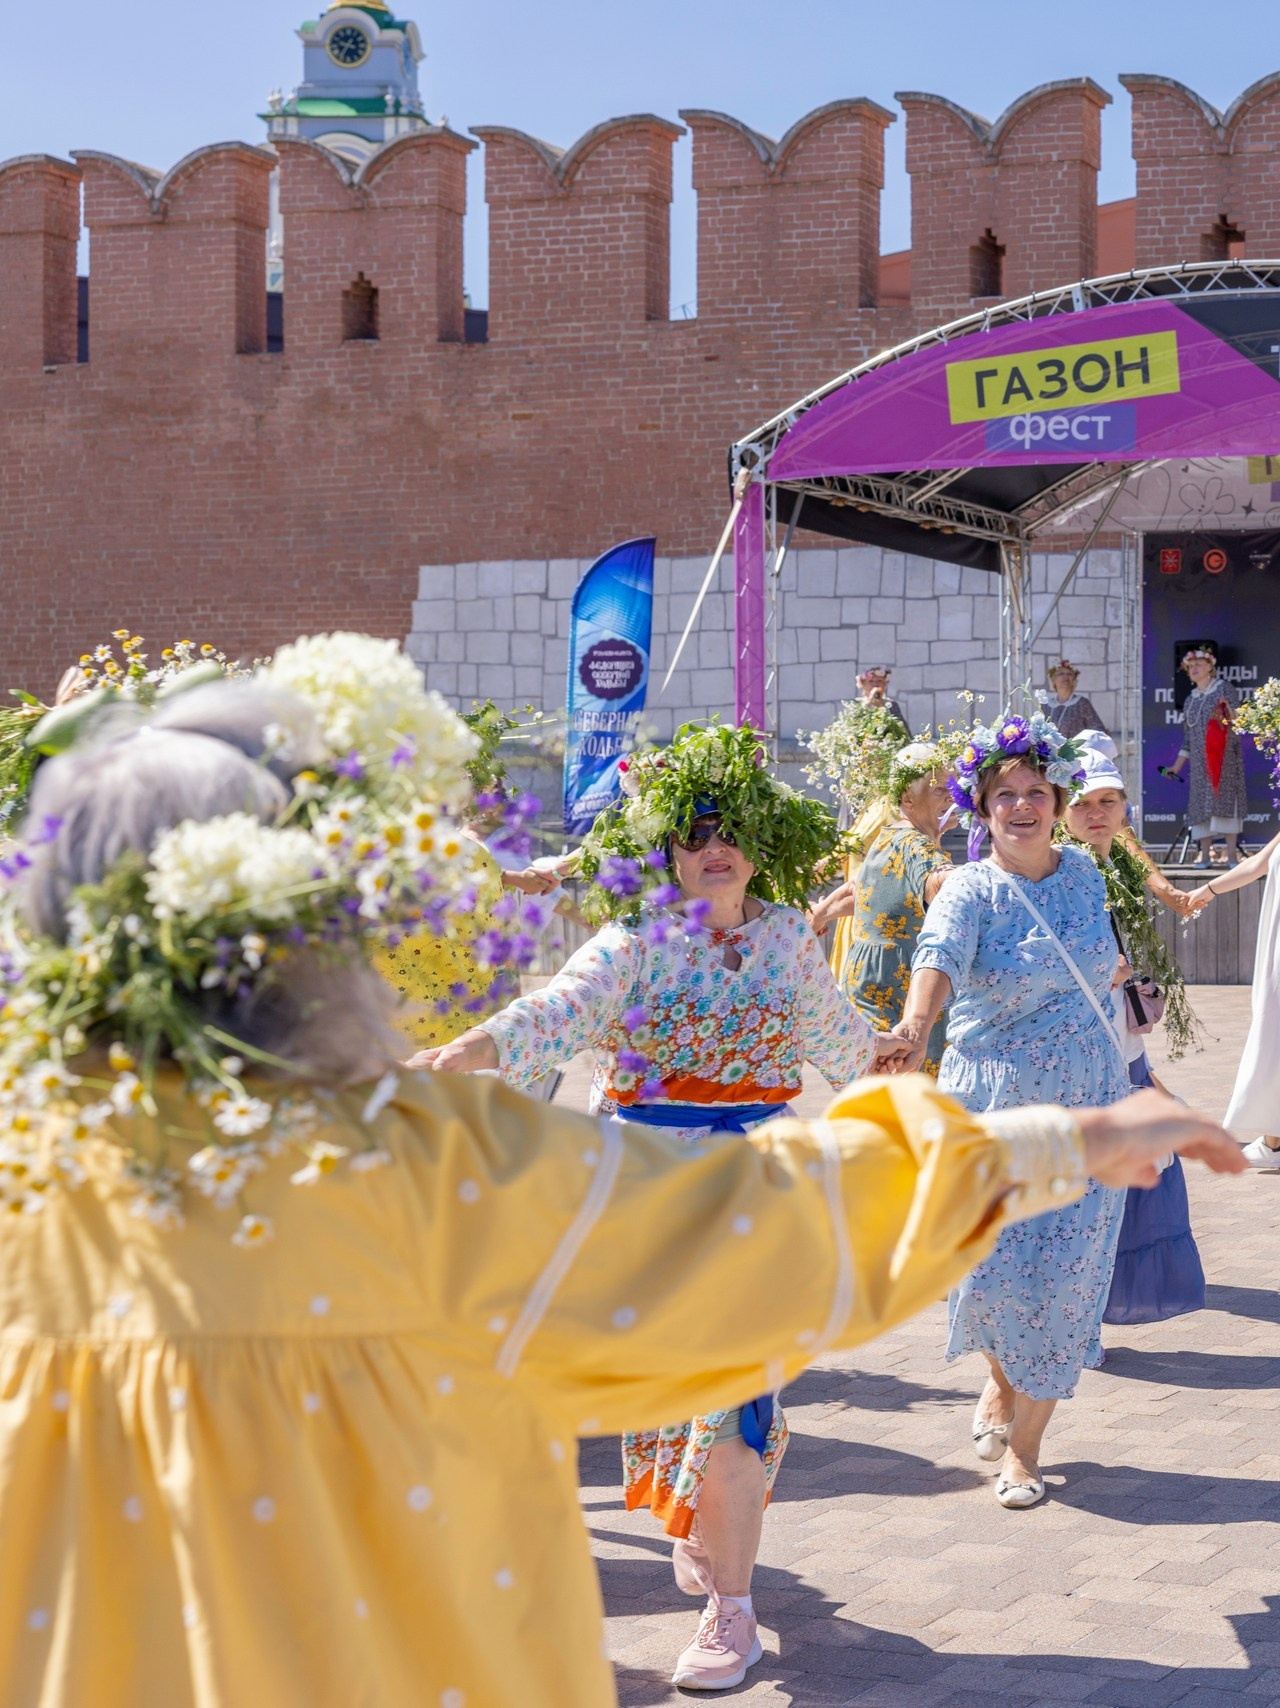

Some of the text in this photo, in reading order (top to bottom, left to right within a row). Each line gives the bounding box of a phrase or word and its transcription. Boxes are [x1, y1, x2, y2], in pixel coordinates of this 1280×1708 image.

[974, 347, 1151, 409] ГАЗОН
[1009, 412, 1111, 449] фест
[1144, 813, 1176, 822] панна
